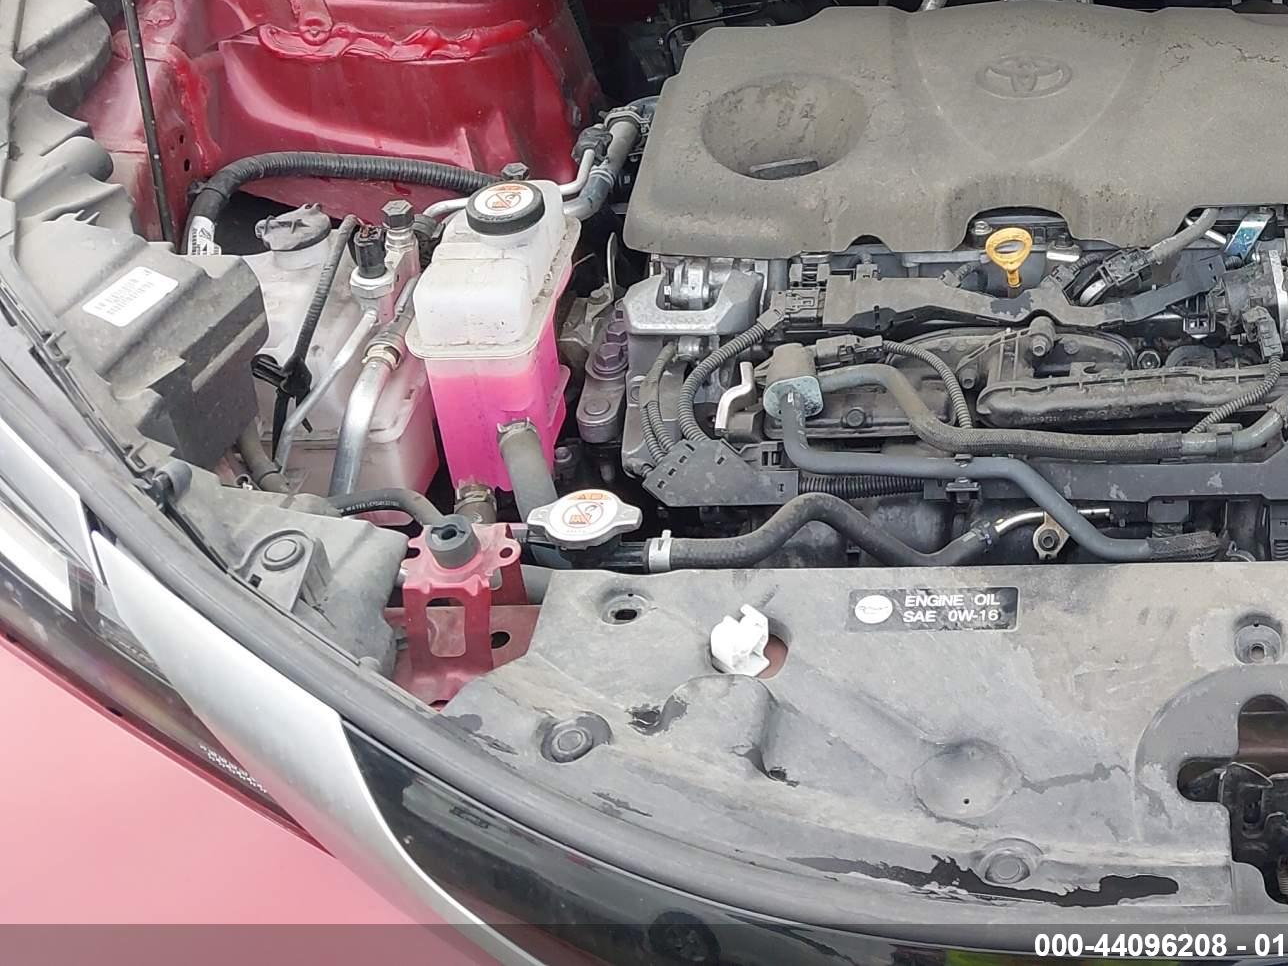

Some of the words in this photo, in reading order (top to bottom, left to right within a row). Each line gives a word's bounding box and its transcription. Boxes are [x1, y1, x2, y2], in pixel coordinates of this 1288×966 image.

[904, 594, 965, 608] ENGINE
[974, 593, 1001, 607] OIL
[903, 610, 937, 623] SAE
[947, 609, 999, 622] 0W-16
